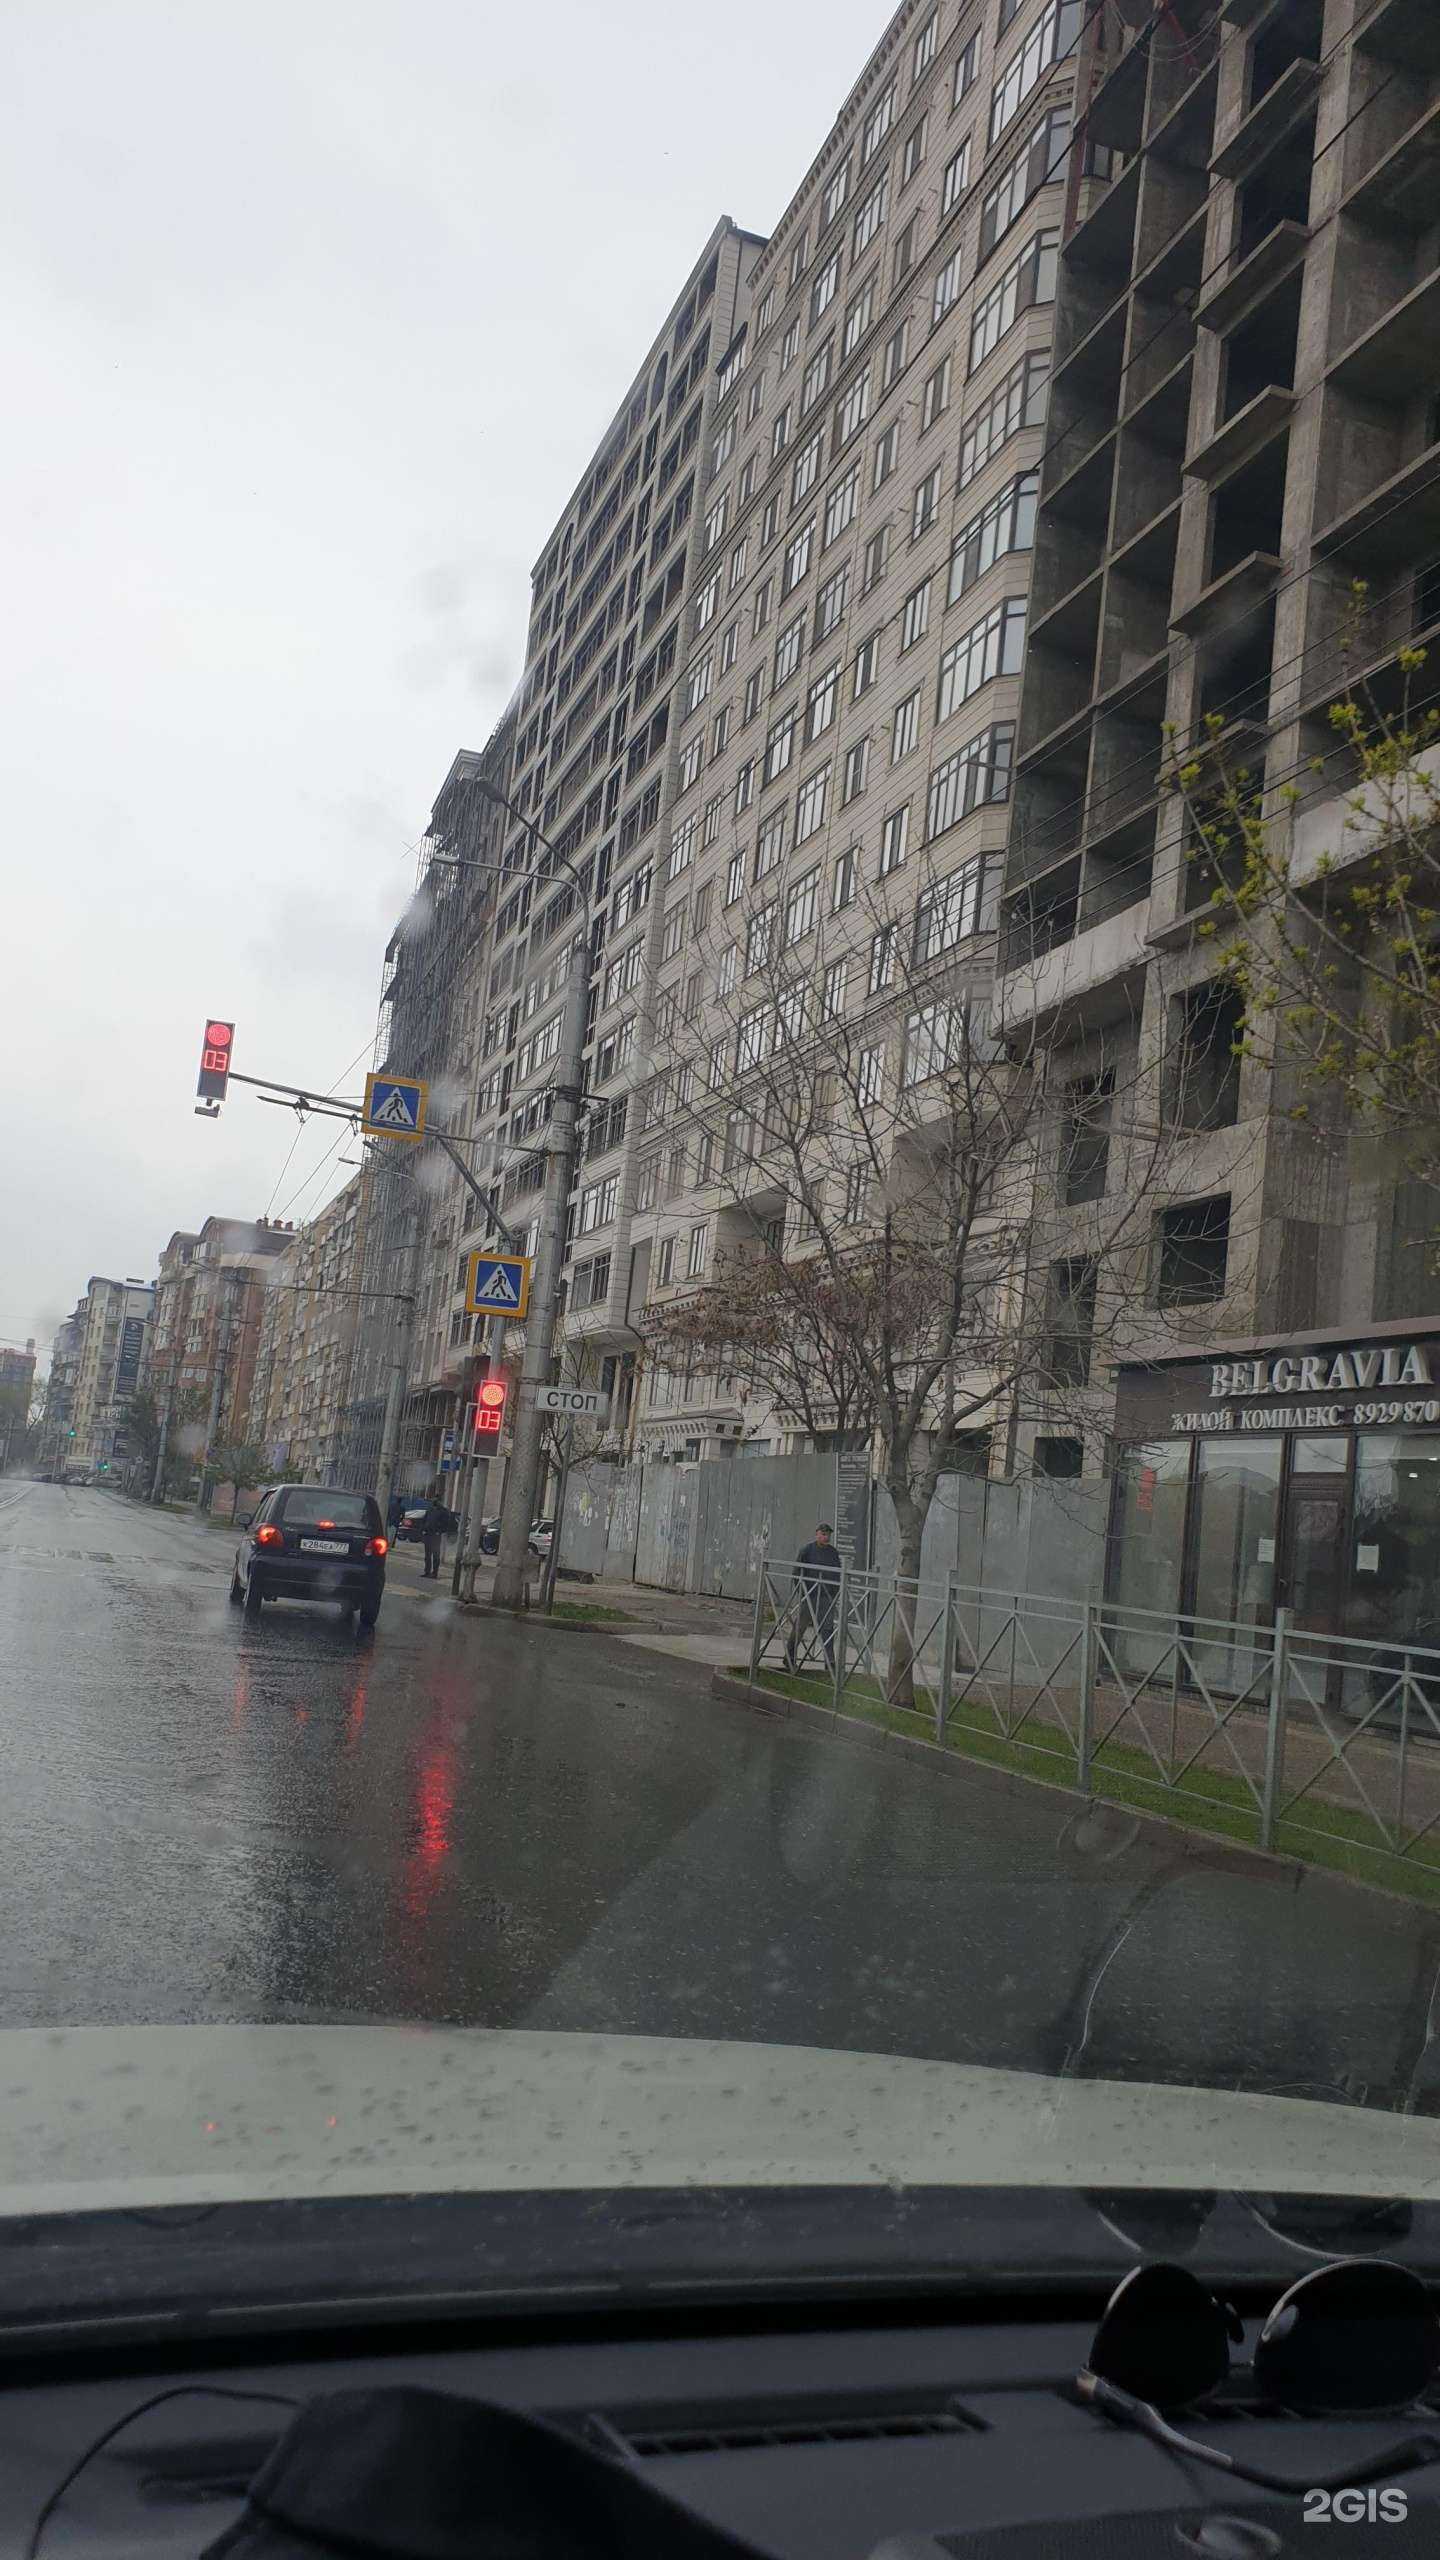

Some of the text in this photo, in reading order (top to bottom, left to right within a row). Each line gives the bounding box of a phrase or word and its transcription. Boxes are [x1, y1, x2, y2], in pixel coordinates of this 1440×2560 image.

[1209, 1346, 1434, 1398] BELGRAVIA
[547, 1391, 598, 1411] СТОП
[1171, 1406, 1236, 1432] ЖИЛОЙ
[1240, 1405, 1346, 1430] КОМПЛЕКС
